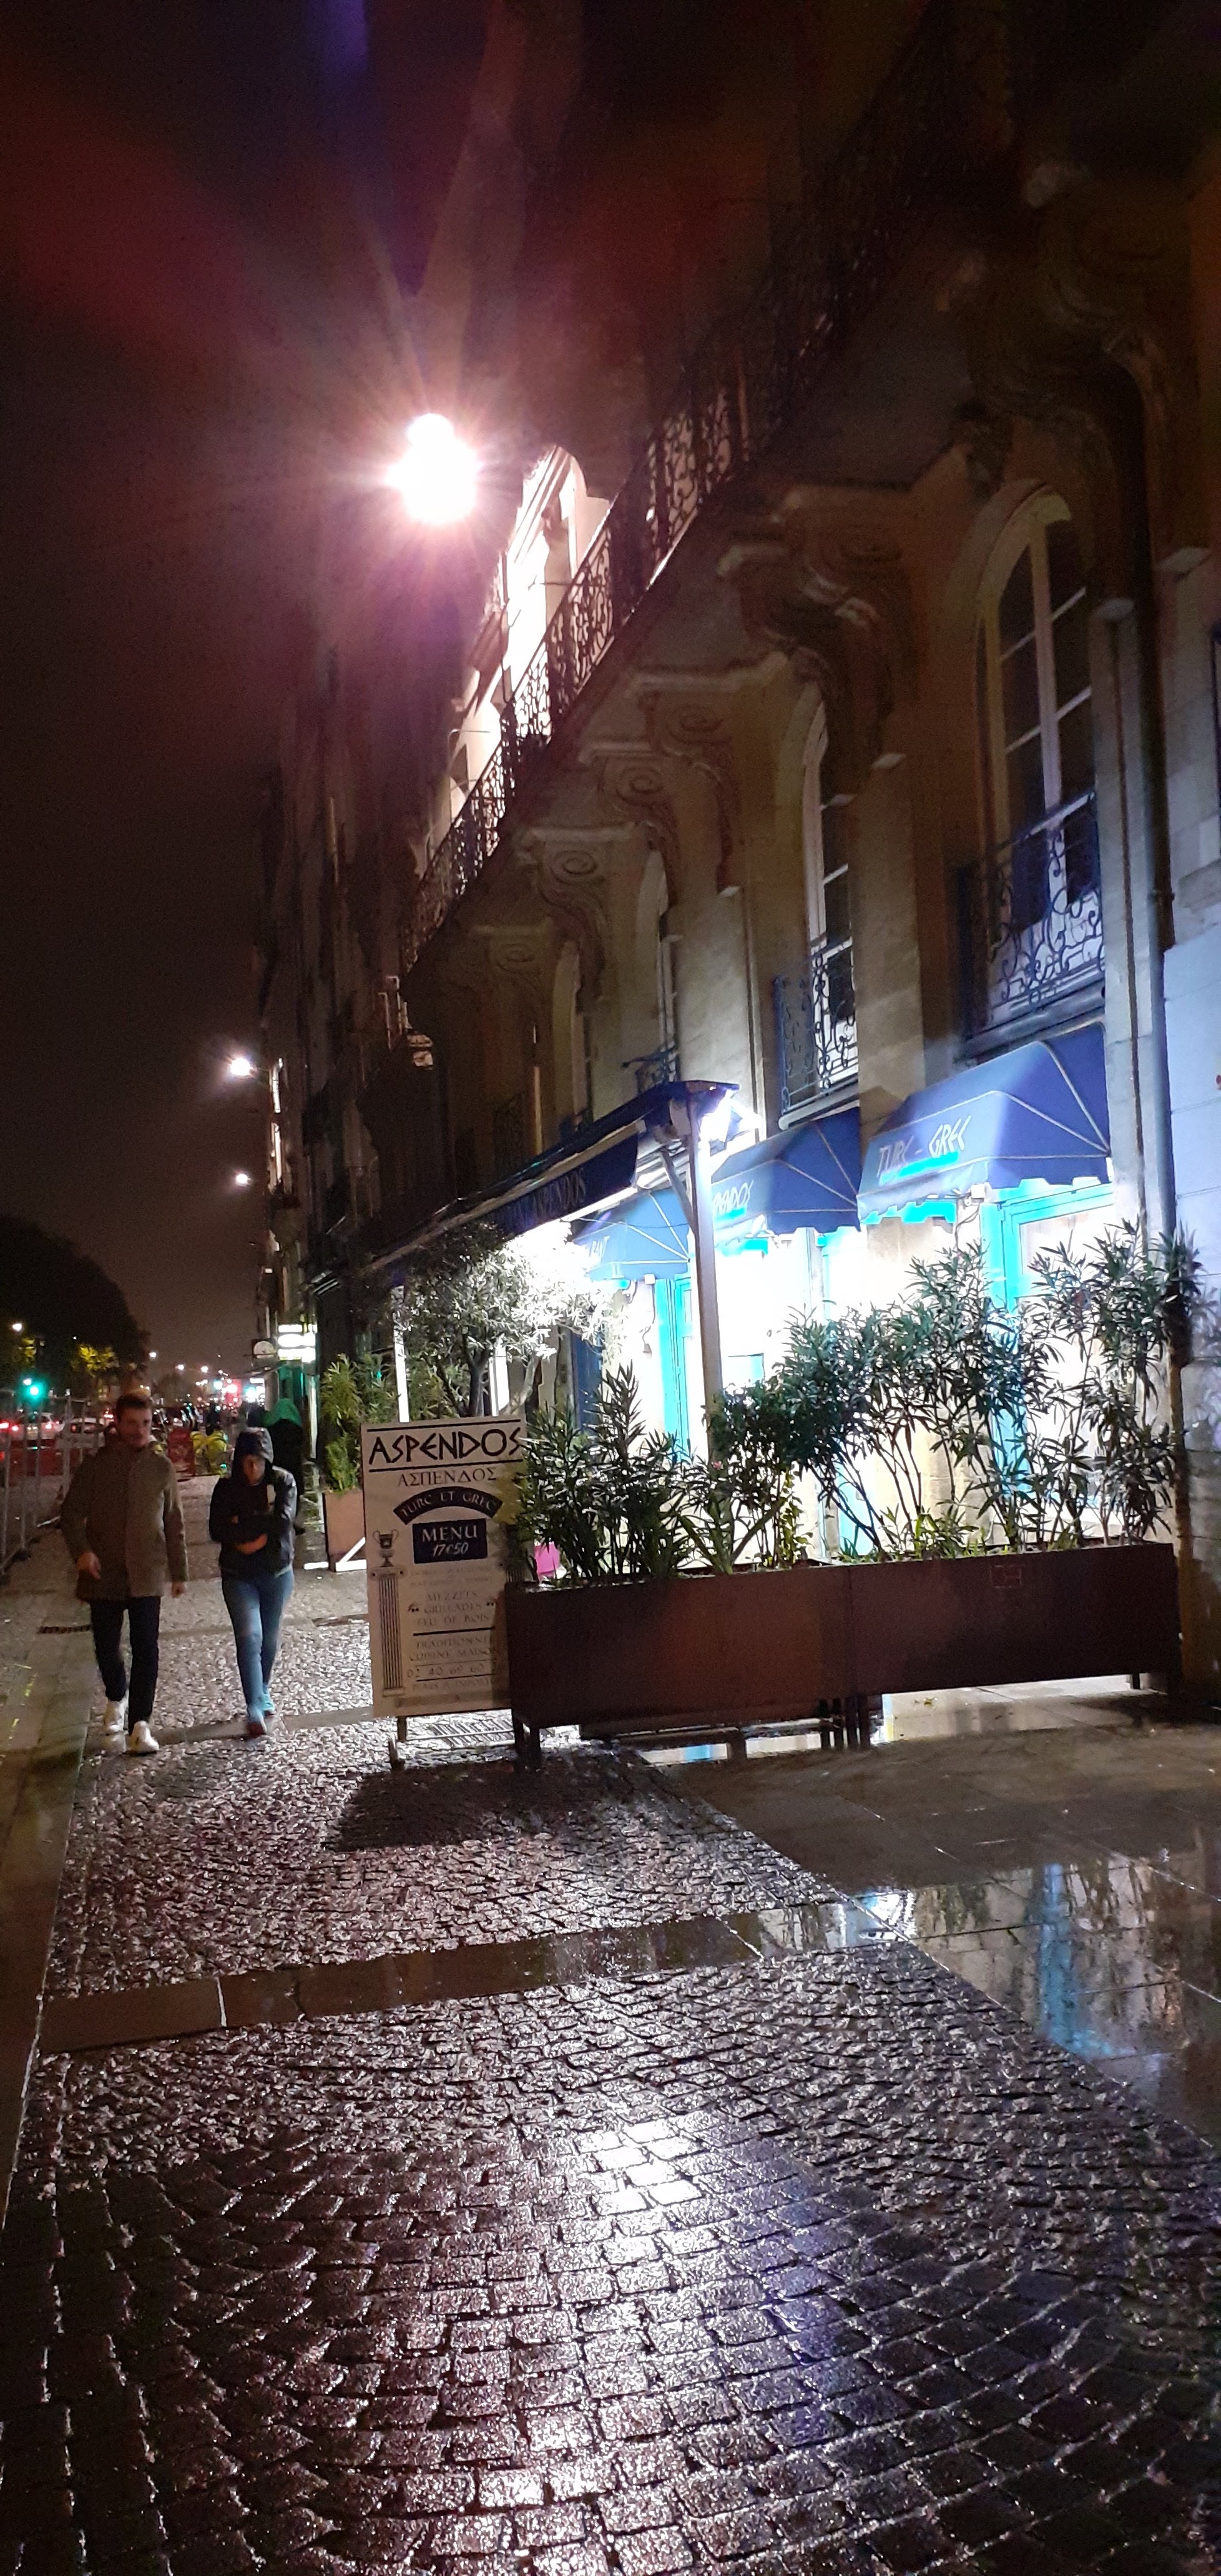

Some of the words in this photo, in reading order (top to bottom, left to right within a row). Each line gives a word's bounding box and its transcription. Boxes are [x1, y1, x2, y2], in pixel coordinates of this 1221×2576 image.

[929, 1115, 972, 1158] GREC
[369, 1427, 523, 1465] ASPENDOS
[401, 1494, 431, 1517] TURC
[440, 1491, 455, 1502] ET
[463, 1493, 496, 1511] GREC
[422, 1524, 478, 1543] MENU
